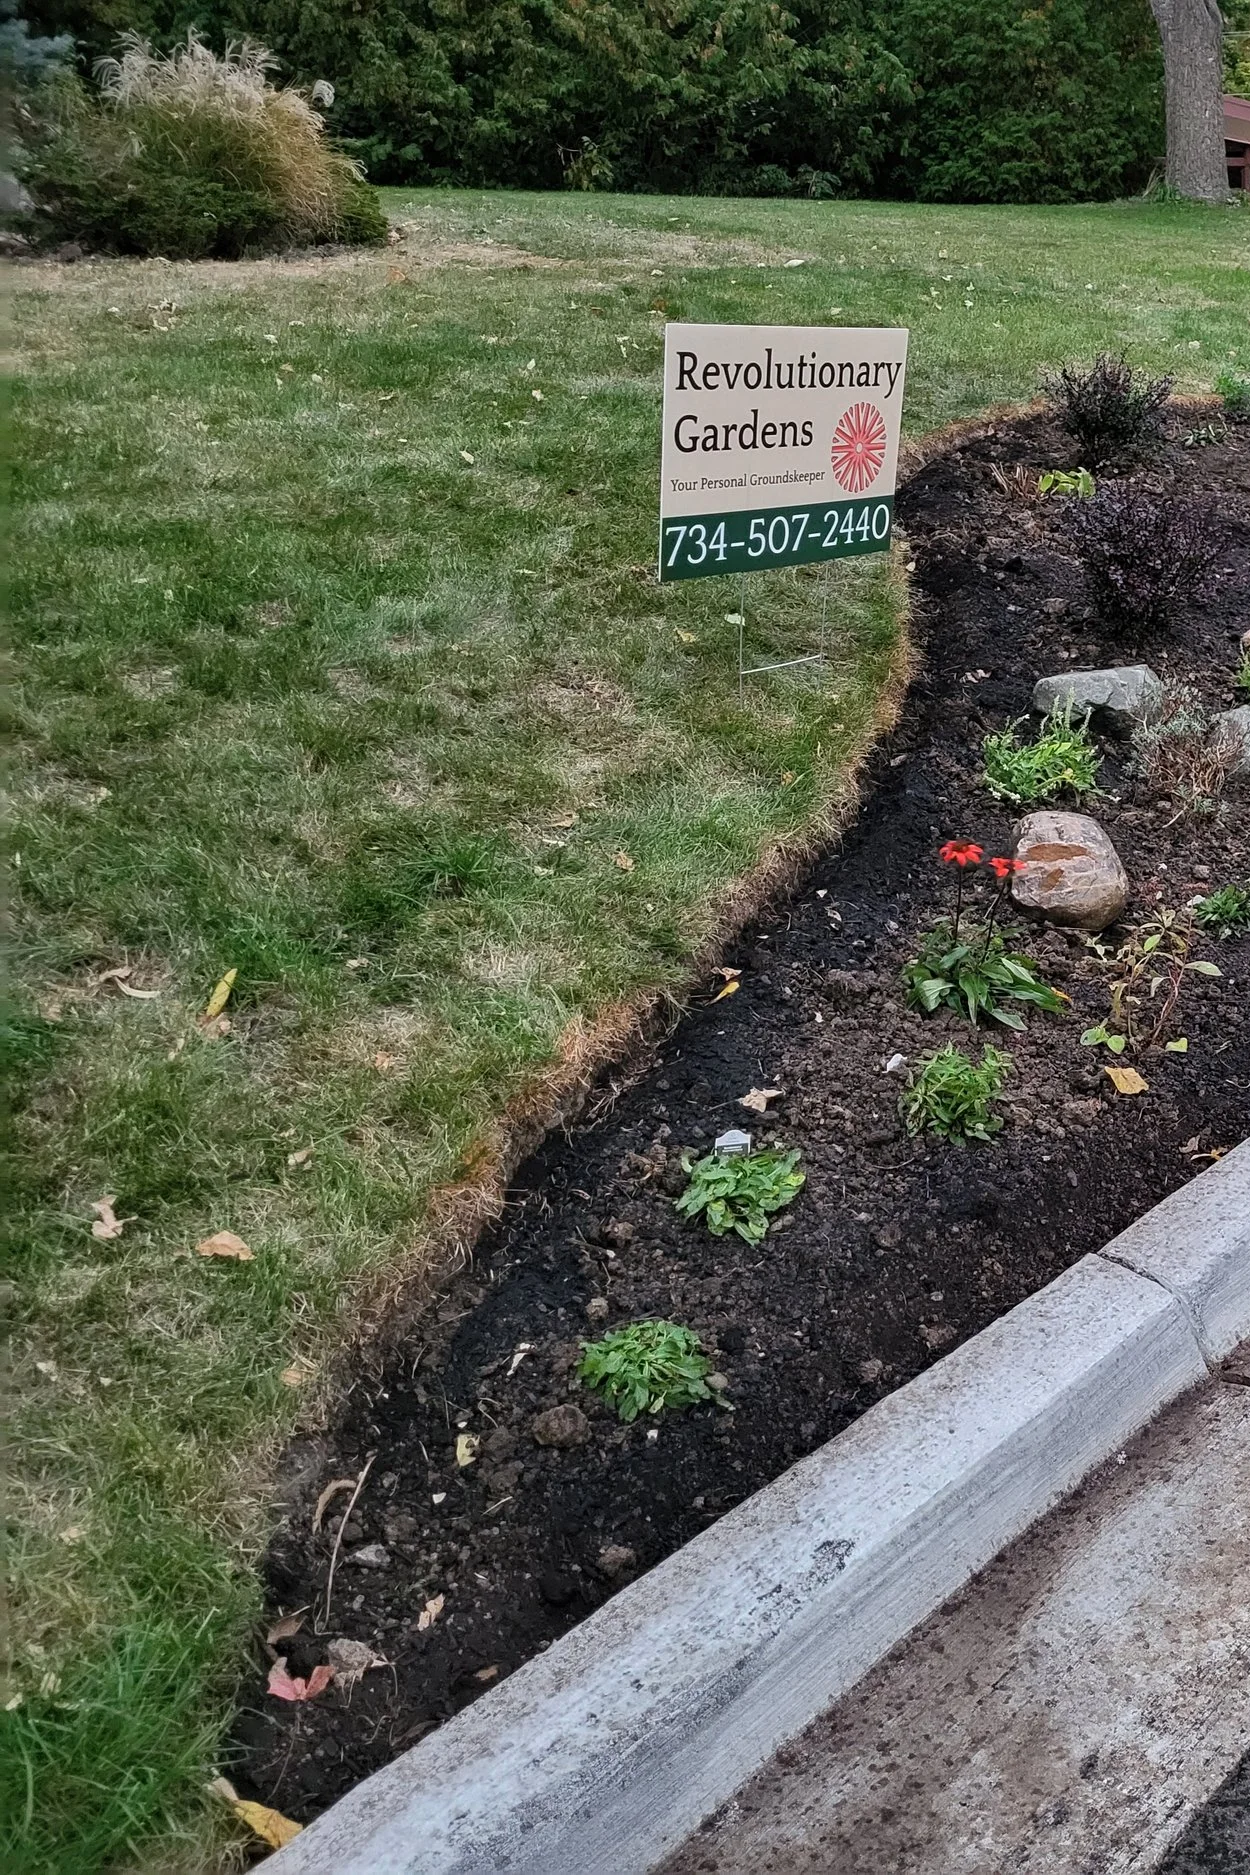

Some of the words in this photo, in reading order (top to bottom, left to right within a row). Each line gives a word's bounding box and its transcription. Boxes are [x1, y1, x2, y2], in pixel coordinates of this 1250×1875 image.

[675, 348, 903, 399] Revolutionary
[674, 409, 813, 453] Gardens
[670, 478, 698, 492] Your
[700, 473, 747, 490] Personal
[749, 469, 826, 487] Groundskeeper
[665, 504, 890, 567] 734-507-2440
